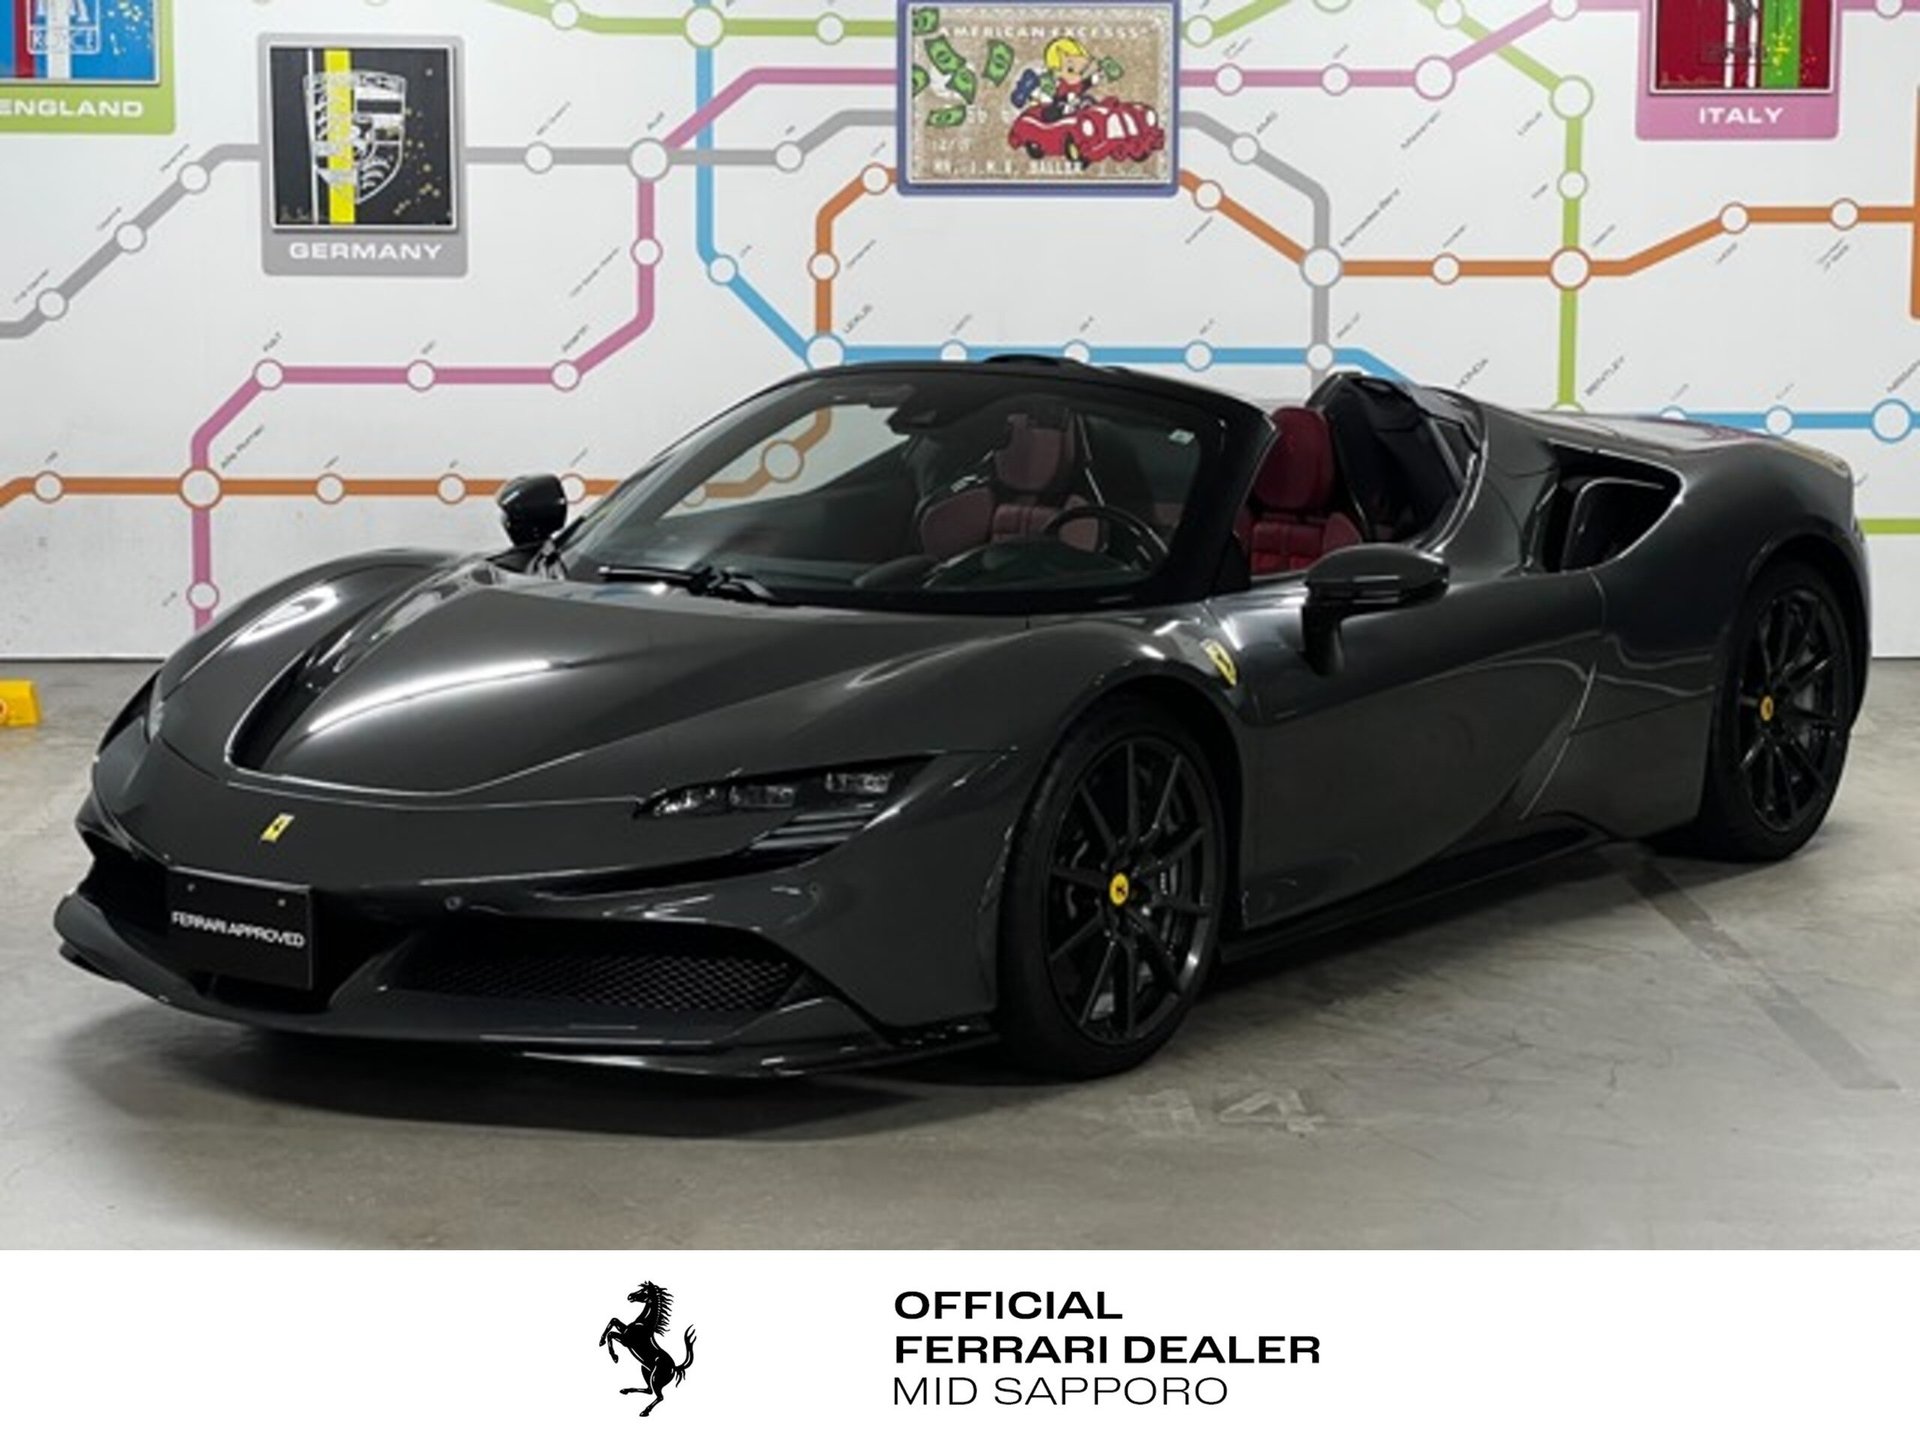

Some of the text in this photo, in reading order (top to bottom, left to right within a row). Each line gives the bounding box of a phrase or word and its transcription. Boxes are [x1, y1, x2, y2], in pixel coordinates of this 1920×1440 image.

[939, 26, 1045, 39] AMERICAN
[0, 100, 143, 117] ENGLAND
[1699, 107, 1784, 124] ITALY
[289, 242, 442, 260] GERMANY
[170, 910, 306, 948] FERRARI APPROVED
